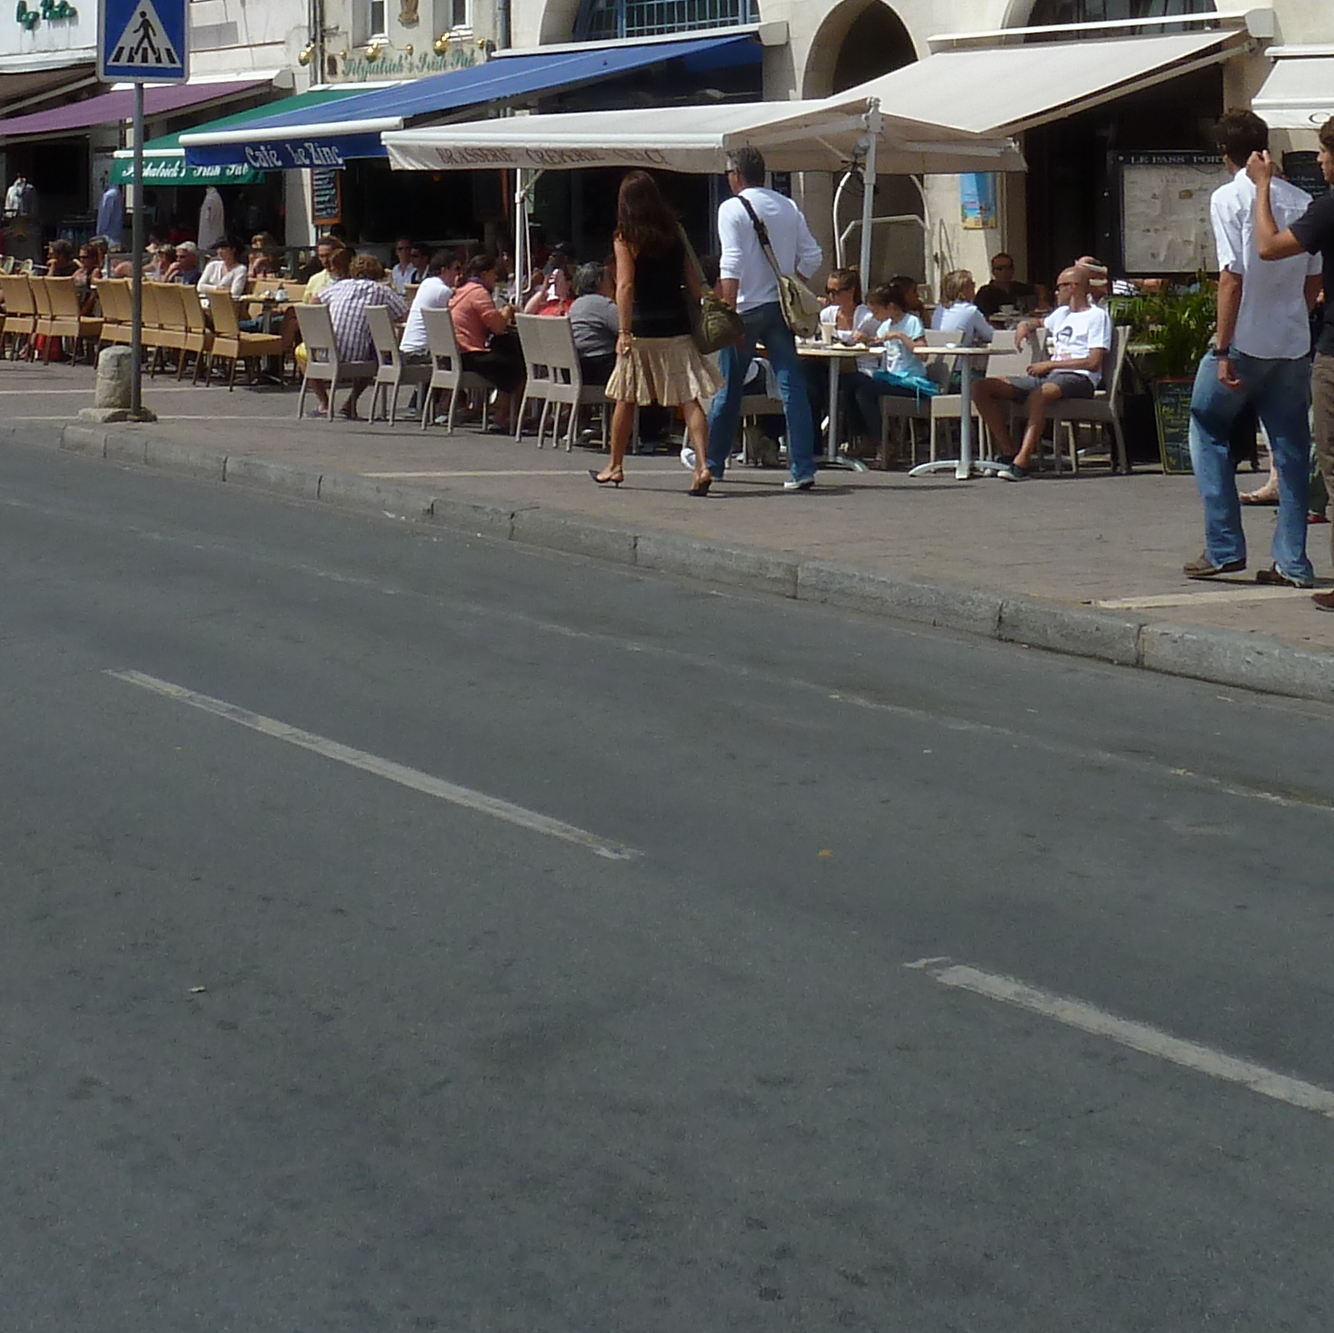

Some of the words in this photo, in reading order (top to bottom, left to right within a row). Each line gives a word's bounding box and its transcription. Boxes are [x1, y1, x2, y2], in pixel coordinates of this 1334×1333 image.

[245, 144, 283, 168] Café
[435, 146, 515, 165] BRASSERIE
[1131, 156, 1149, 164] LE
